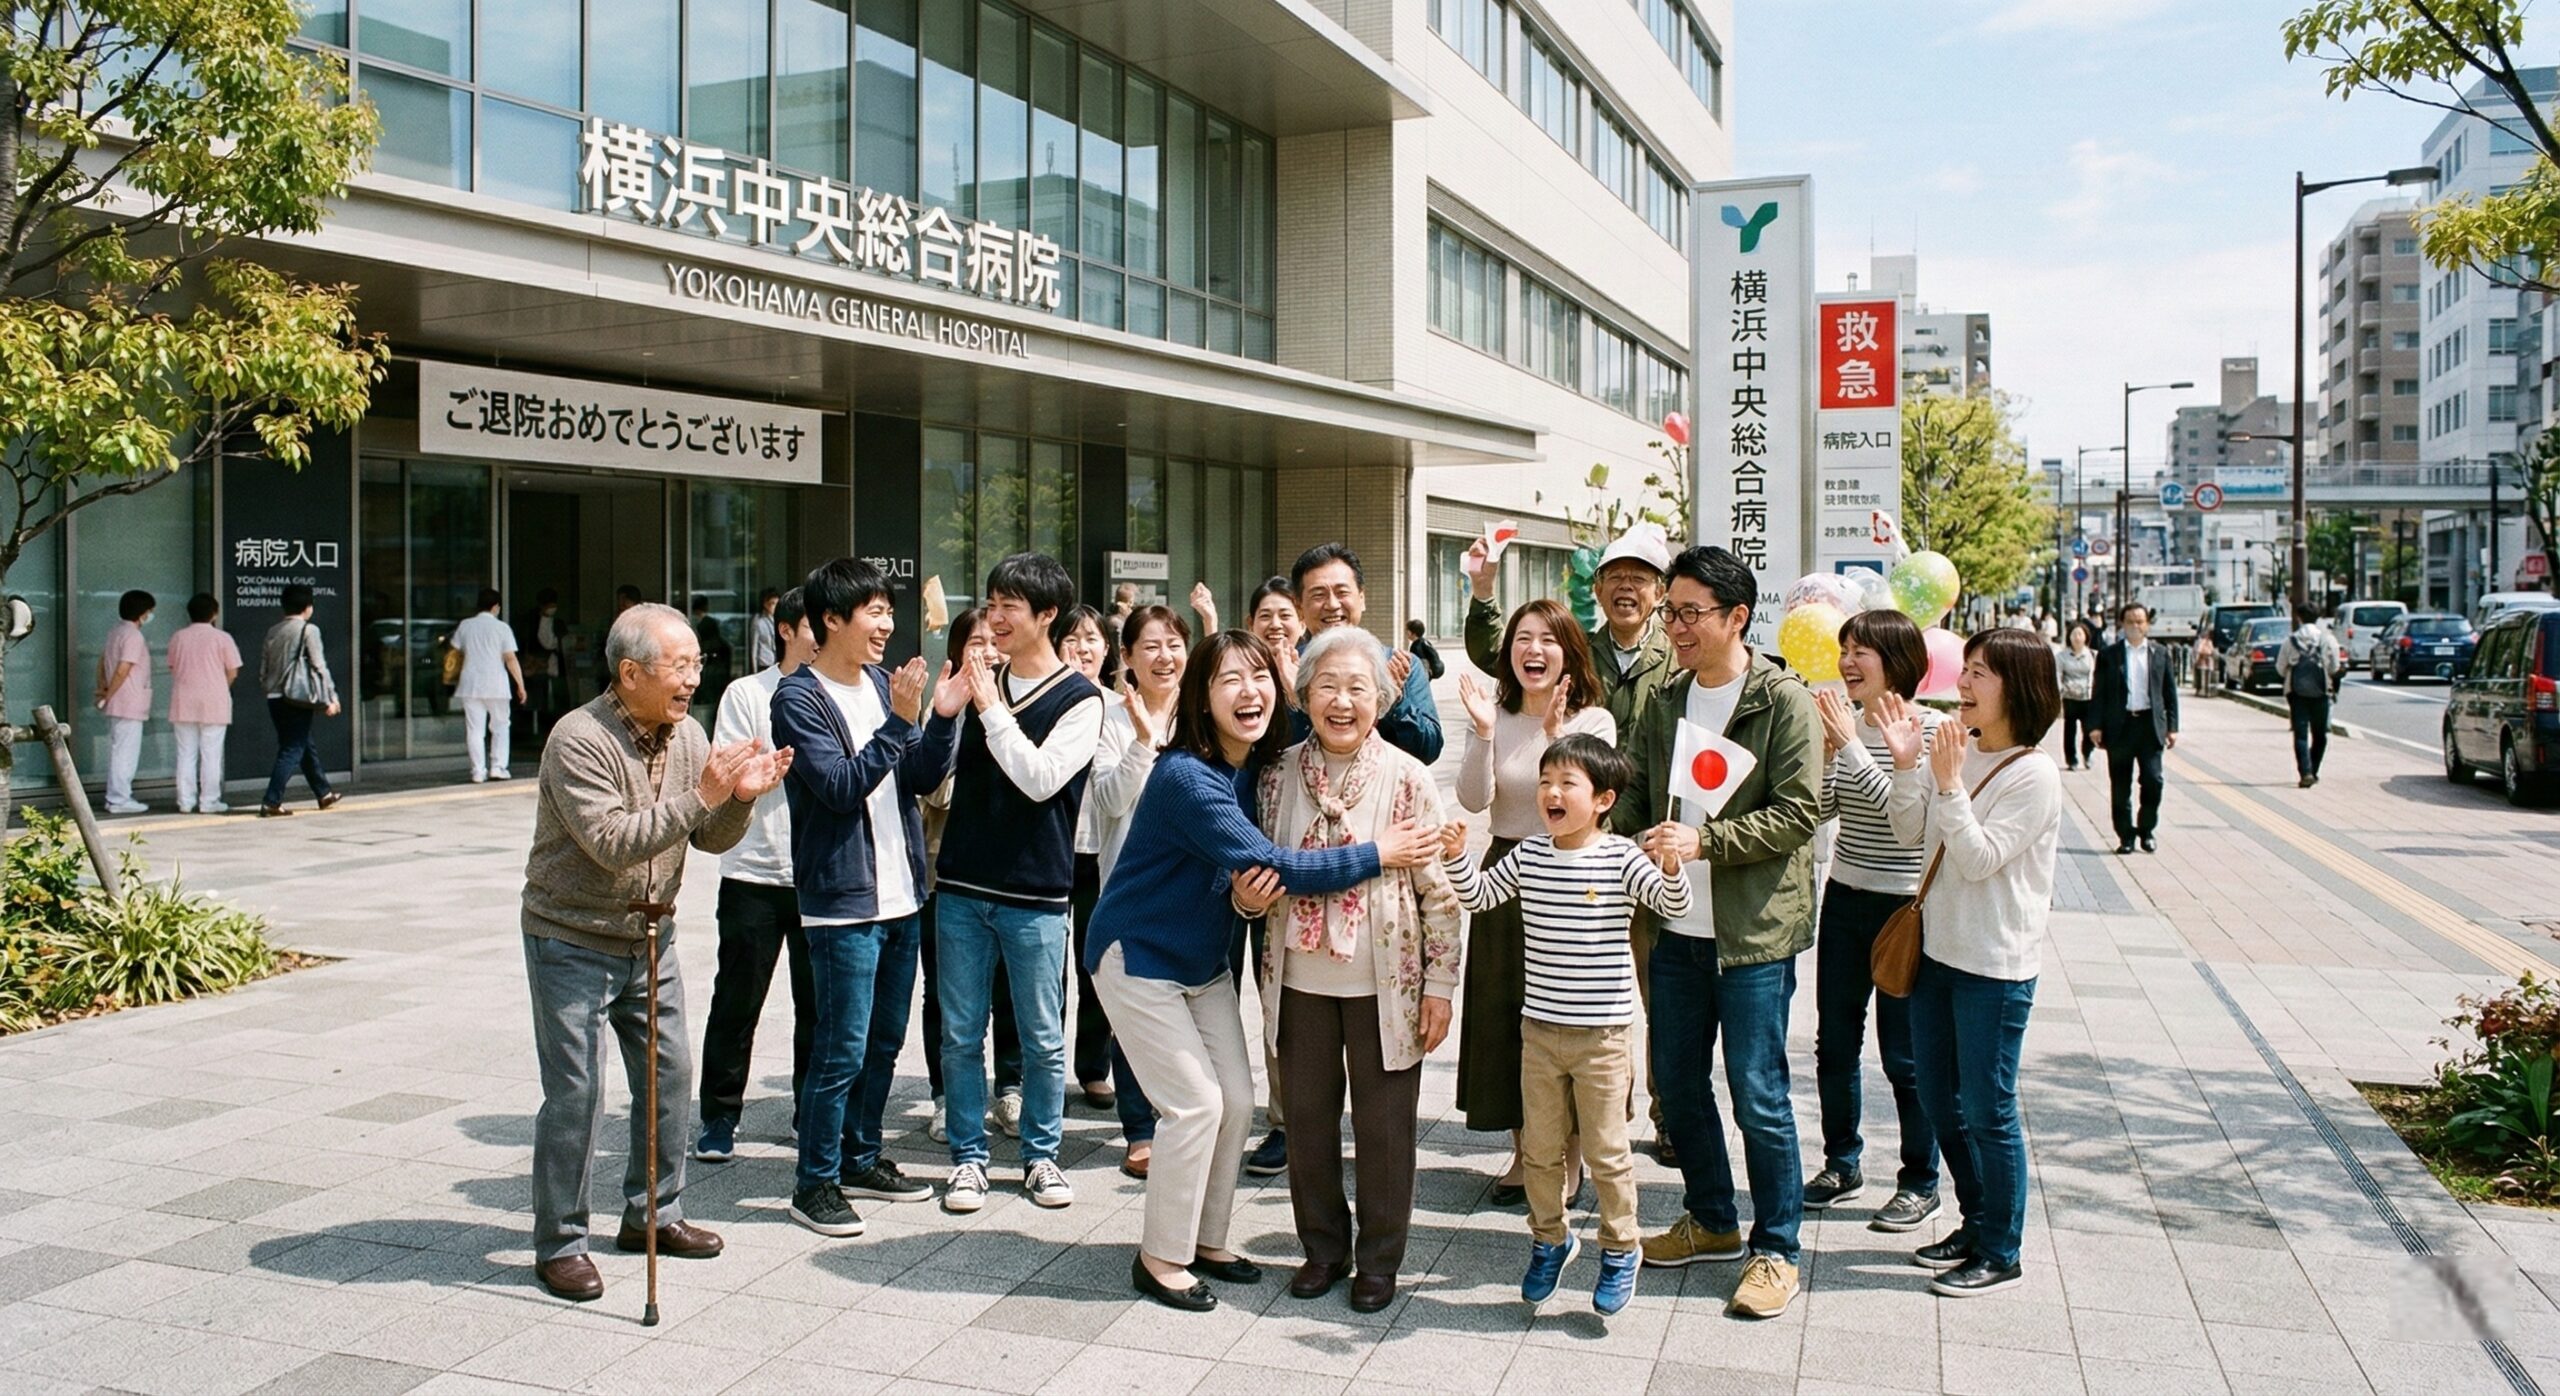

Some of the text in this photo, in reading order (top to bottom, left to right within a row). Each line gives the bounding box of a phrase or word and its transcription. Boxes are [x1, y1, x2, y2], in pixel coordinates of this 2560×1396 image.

[578, 117, 1061, 309] 横浜中央総合病院
[667, 262, 1030, 358] YOKOHAMA GENERAL HOSPITAL
[1837, 311, 1878, 399] 救急
[446, 387, 805, 462] ご退院おめでとうございます
[1731, 269, 1767, 570] 横浜中央総合病院
[1824, 431, 1891, 450] 病院入口
[235, 537, 338, 568] 病院入口
[861, 556, 914, 578] 院入口
